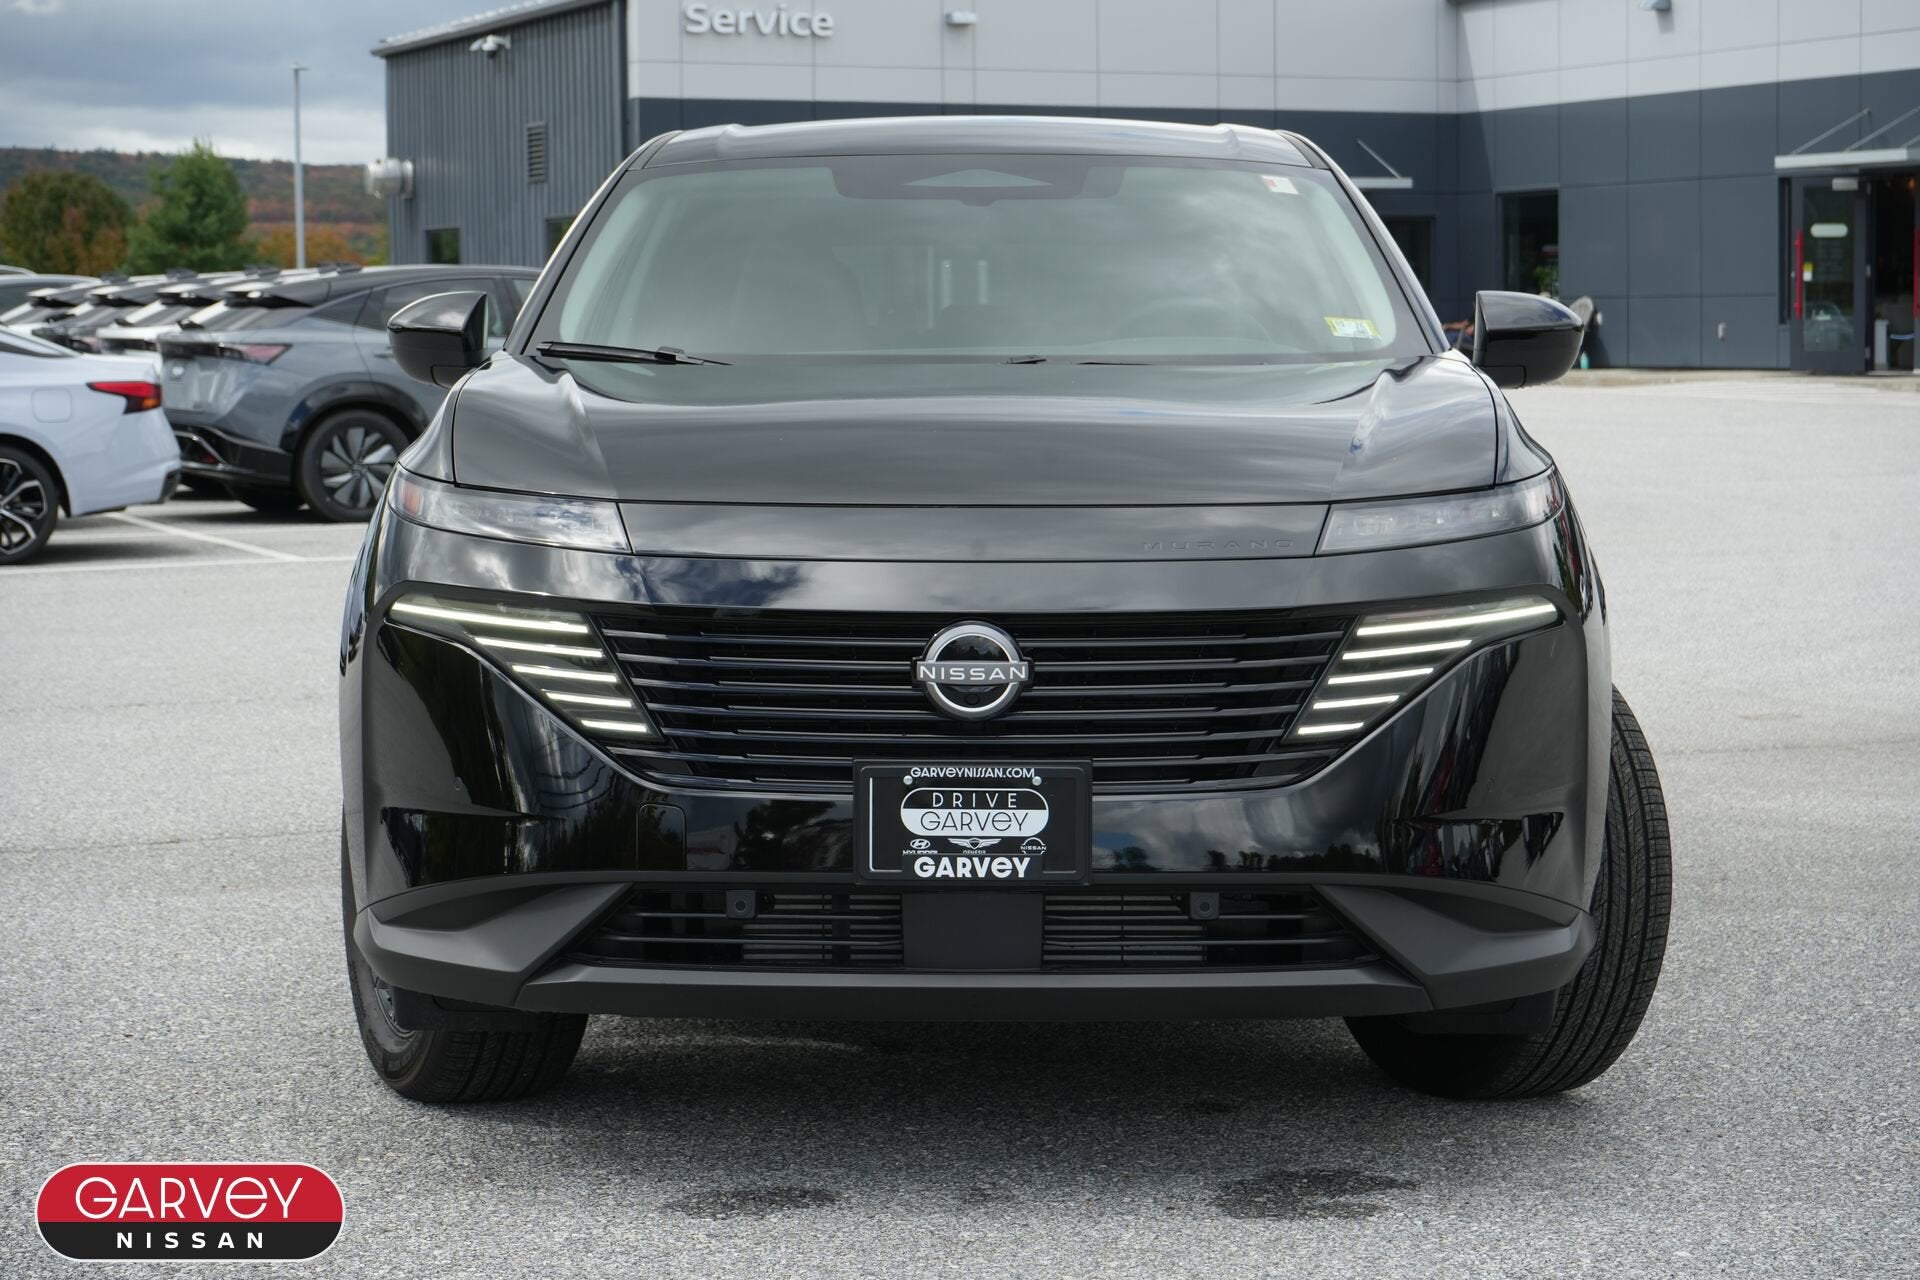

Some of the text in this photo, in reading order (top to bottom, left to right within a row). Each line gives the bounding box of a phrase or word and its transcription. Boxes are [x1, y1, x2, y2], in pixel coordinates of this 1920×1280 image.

[685, 3, 834, 37] Service
[1144, 540, 1294, 551] MURANO
[920, 665, 1026, 680] NISSAN
[932, 792, 1017, 808] DRIVE
